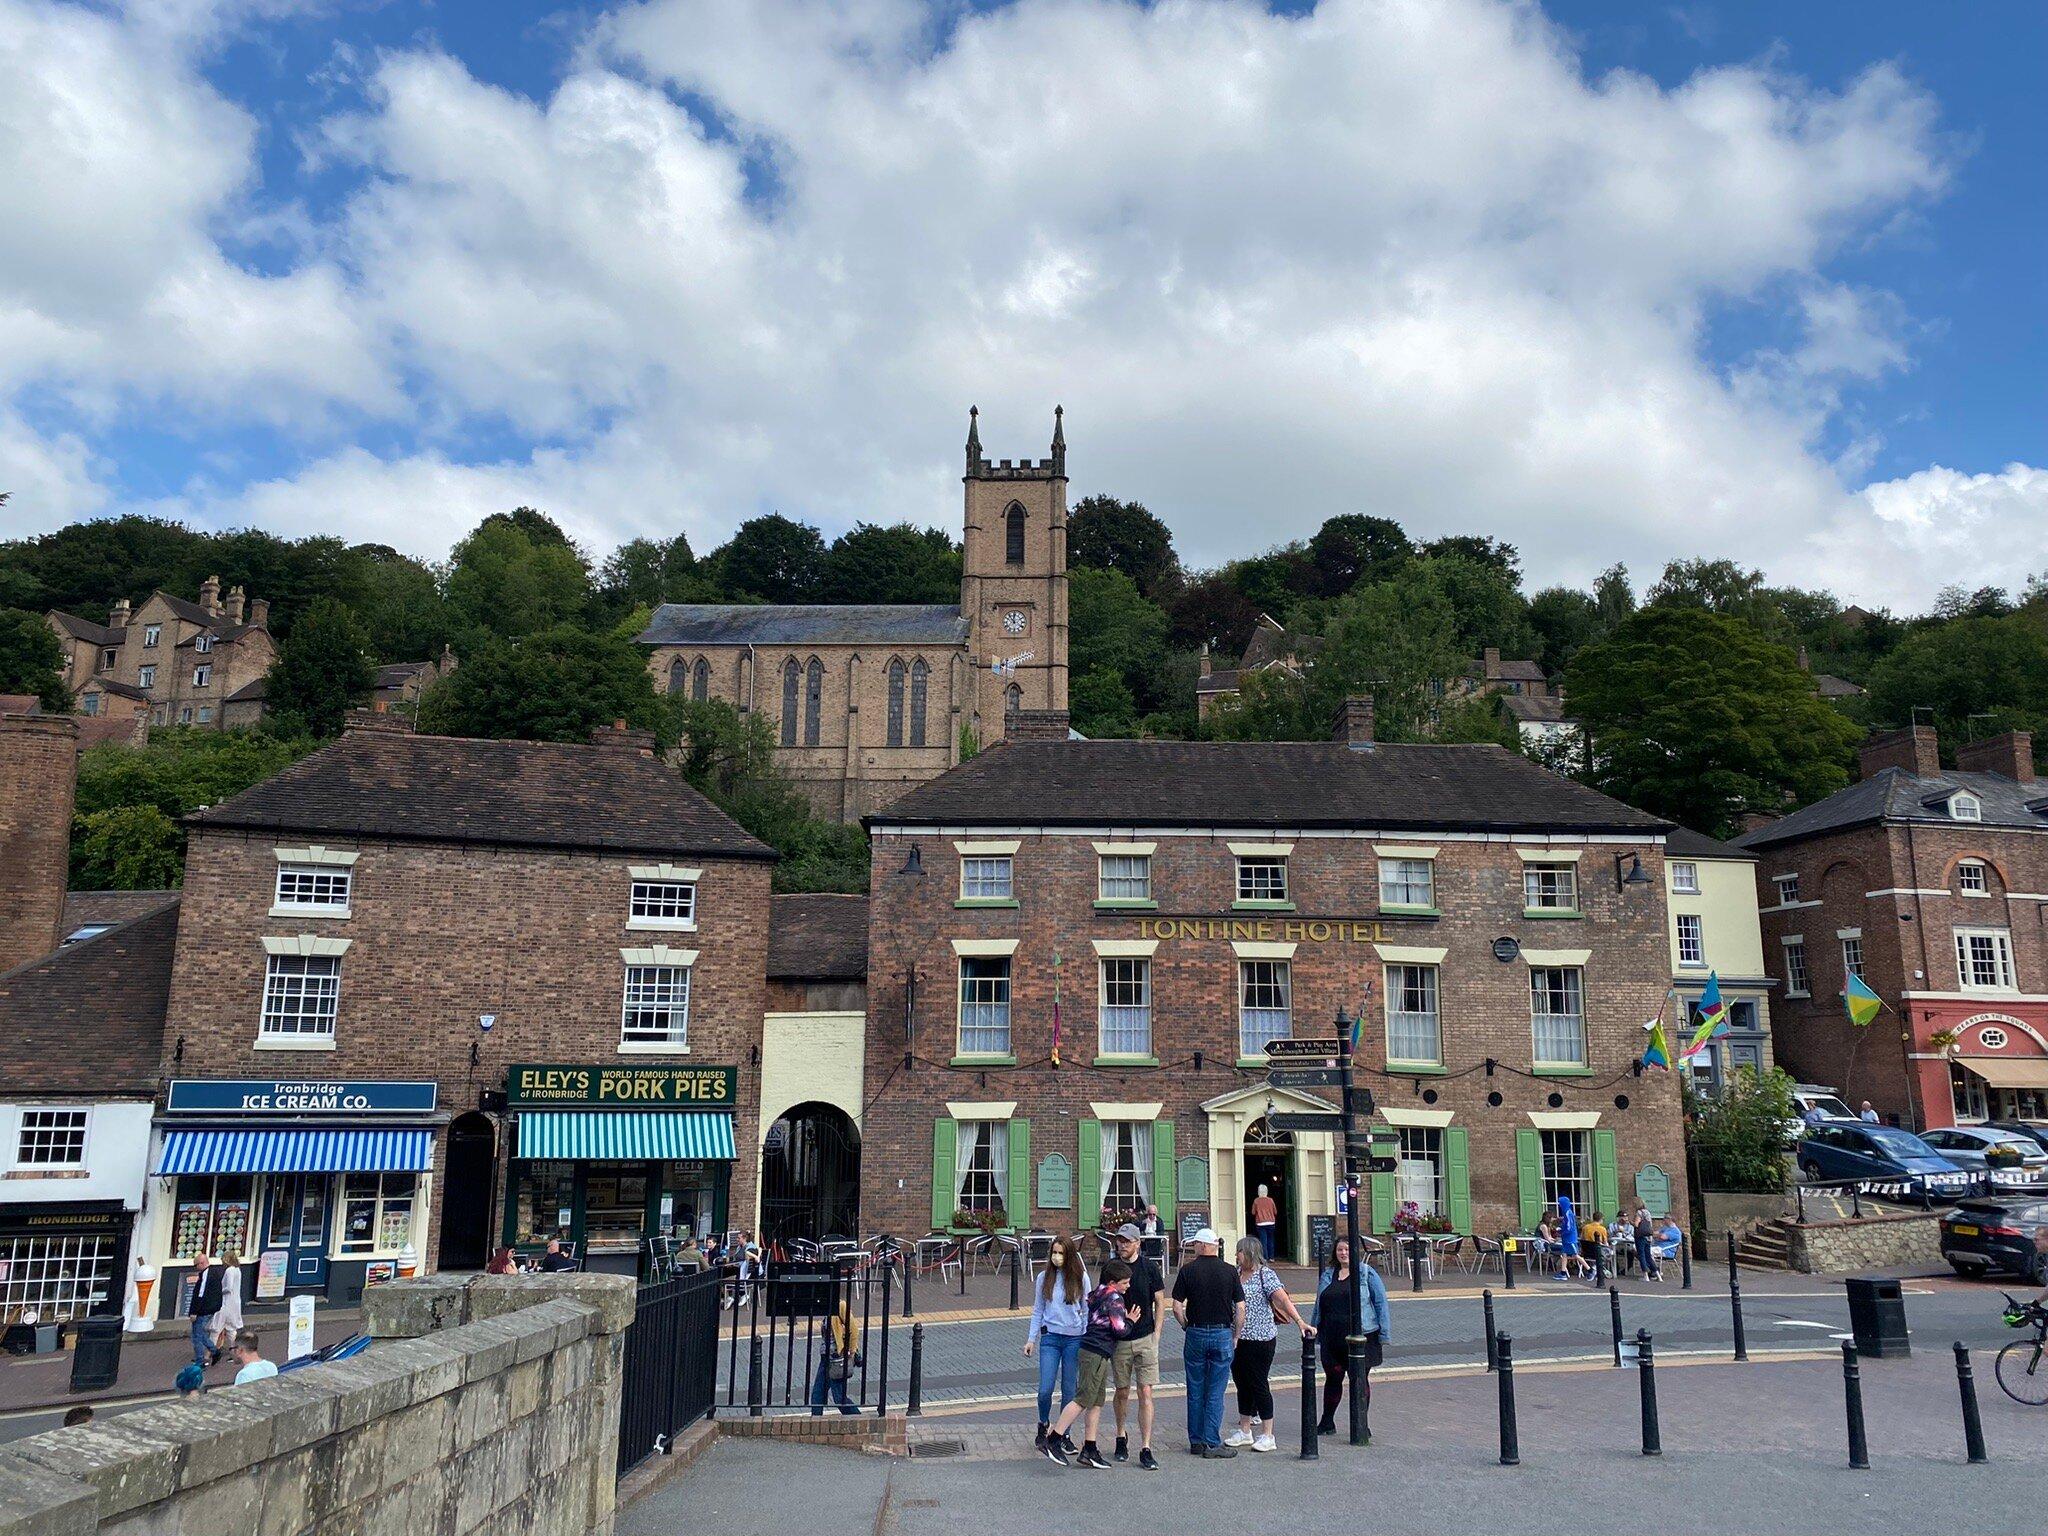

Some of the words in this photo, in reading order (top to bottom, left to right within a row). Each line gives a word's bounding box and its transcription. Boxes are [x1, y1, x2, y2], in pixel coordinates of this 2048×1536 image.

[1134, 919, 1276, 941] TONTINE
[1284, 920, 1394, 942] HOTEL
[1956, 1016, 1979, 1032] BEARS
[2006, 1016, 2033, 1032] SQUARE
[521, 1070, 589, 1089] ELEY'S
[602, 1070, 632, 1079] WORLD
[634, 1070, 669, 1079] FAMOUS
[671, 1070, 695, 1079] HAND
[697, 1071, 726, 1079] RAISED
[274, 1083, 344, 1096] Ironbridge
[519, 1089, 529, 1098] of
[532, 1090, 589, 1098] IRONBRIDGE
[599, 1079, 666, 1099] PORK
[675, 1079, 727, 1099] PIES
[241, 1095, 270, 1109] ICE
[275, 1095, 337, 1109] CREAM
[342, 1095, 372, 1109] CO.
[27, 1214, 110, 1225] IRONBRIDGE
